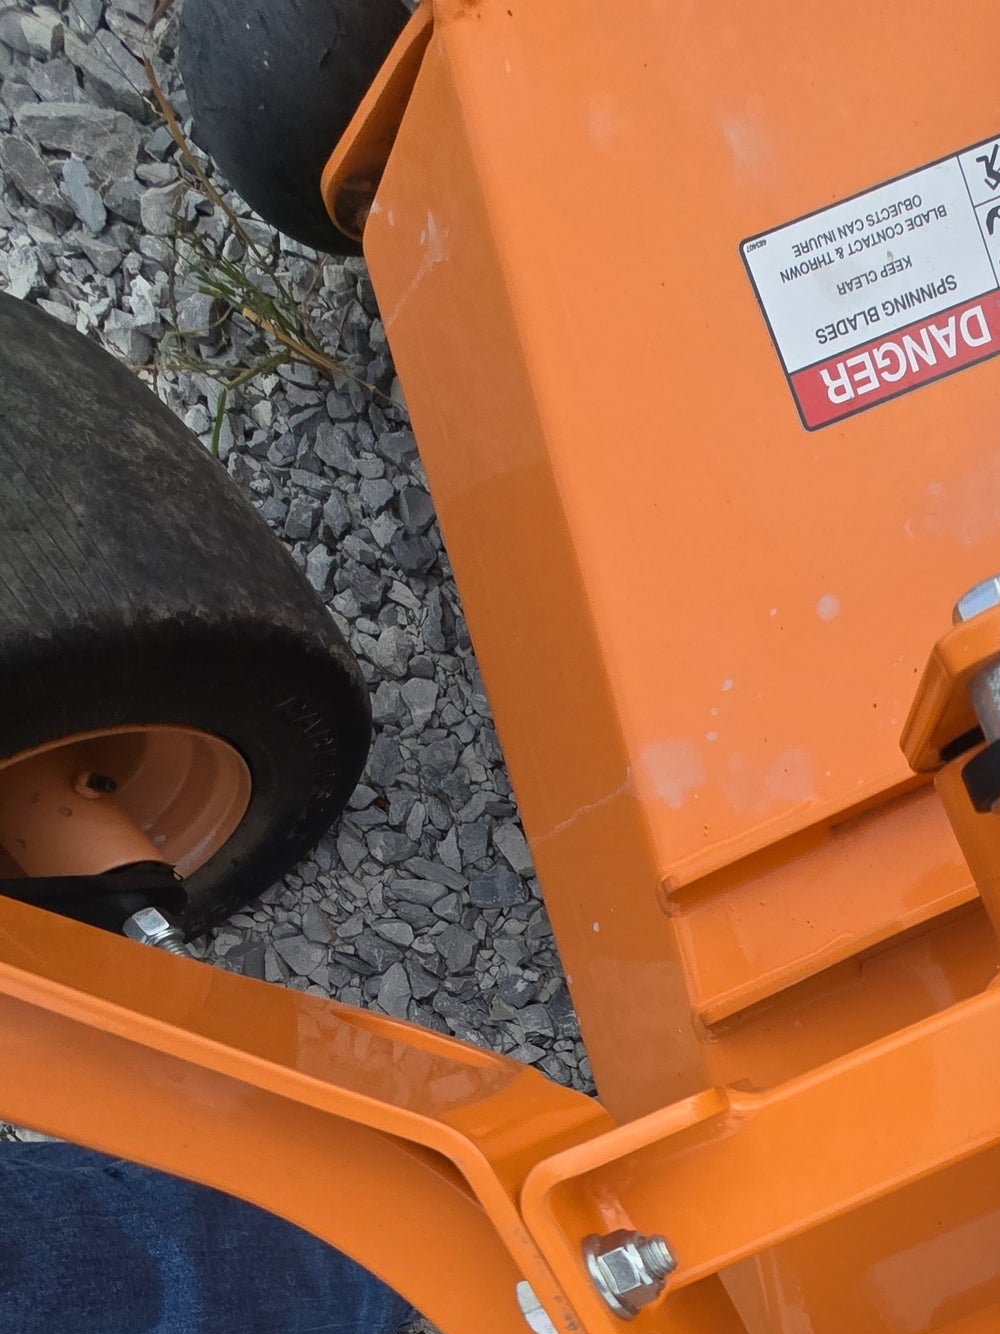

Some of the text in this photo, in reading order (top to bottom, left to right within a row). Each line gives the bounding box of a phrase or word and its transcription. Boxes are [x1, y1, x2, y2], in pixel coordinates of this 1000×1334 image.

[779, 204, 948, 283] BLADE CONTACT & THROWN
[791, 194, 923, 258] OBJECTS CAN INJURE
[815, 274, 958, 345] SPINNING BLADES
[836, 255, 913, 296] KEEP CLEAR
[819, 304, 992, 404] DANGER
